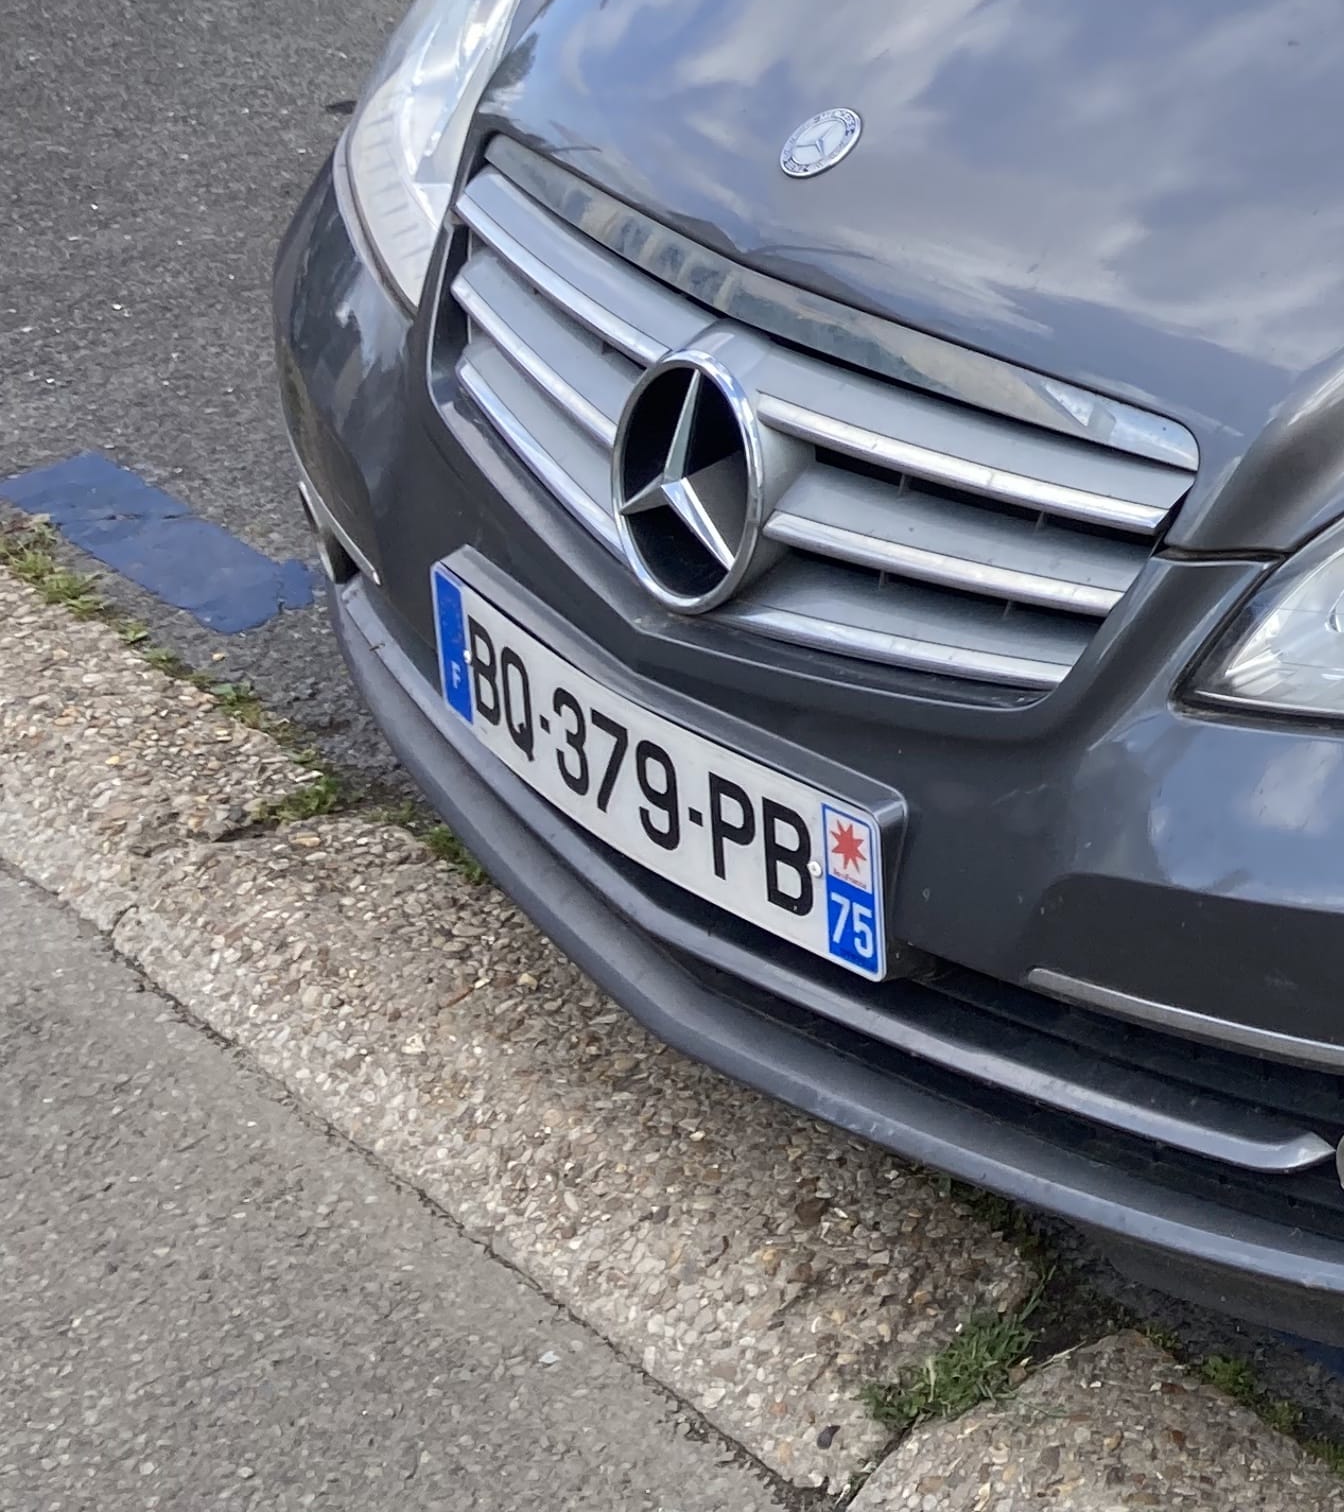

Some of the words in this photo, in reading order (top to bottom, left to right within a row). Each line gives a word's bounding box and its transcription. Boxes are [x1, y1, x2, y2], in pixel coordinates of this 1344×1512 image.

[451, 660, 462, 689] F
[468, 615, 814, 917] BQ-379-PB
[831, 891, 874, 959] 75
